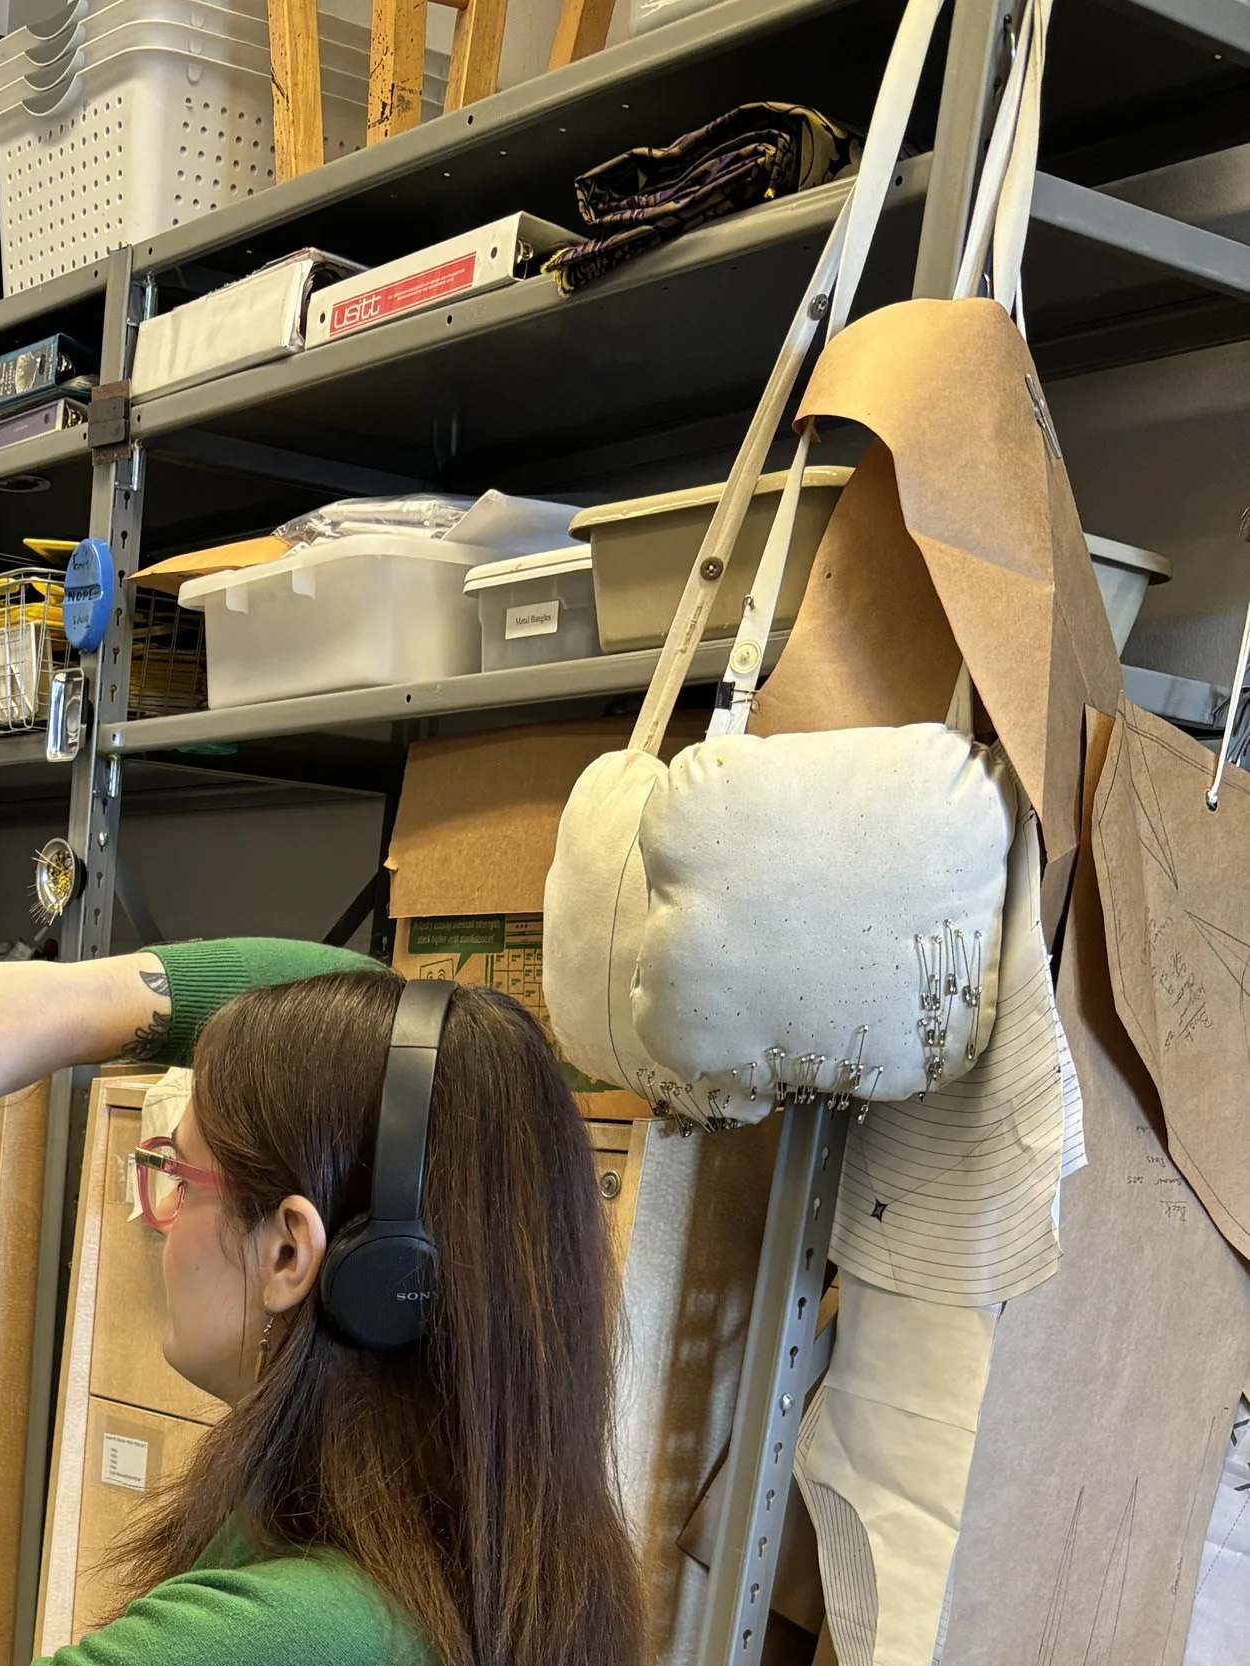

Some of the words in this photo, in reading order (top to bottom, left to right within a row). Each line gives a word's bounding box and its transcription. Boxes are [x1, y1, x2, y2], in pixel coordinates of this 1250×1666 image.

[334, 293, 382, 329] usitt
[515, 616, 530, 624] Metal
[530, 614, 551, 624] Bangles
